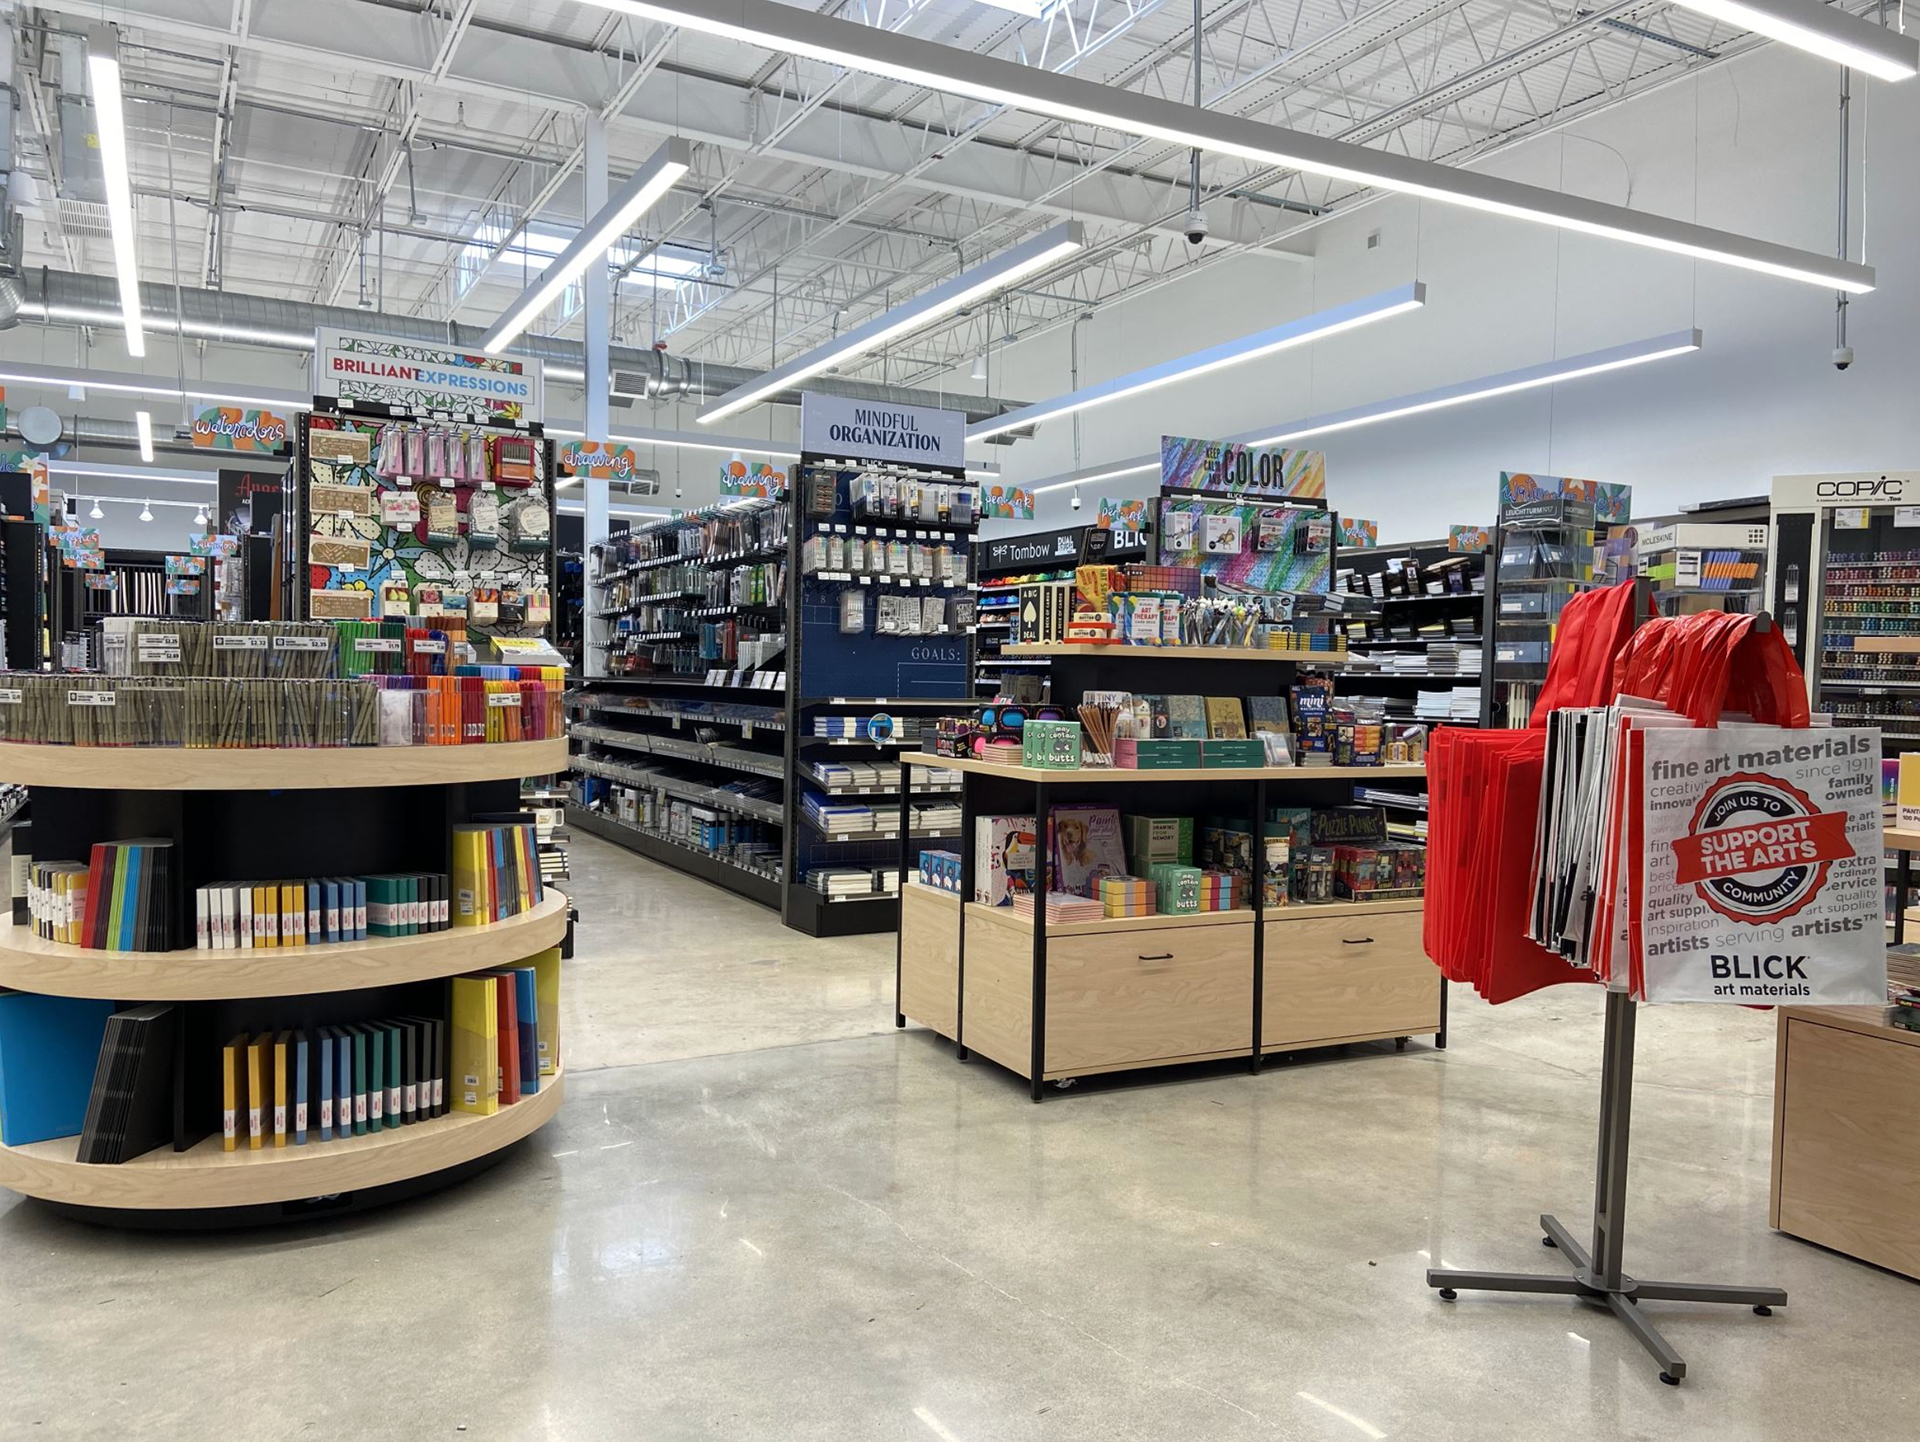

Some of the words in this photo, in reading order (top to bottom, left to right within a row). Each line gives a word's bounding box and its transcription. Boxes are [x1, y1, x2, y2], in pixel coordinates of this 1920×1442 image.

[195, 412, 285, 441] watercolors
[854, 408, 919, 432] MINDFUL
[829, 424, 941, 452] ORGANIZATION
[564, 445, 633, 477] drawing
[861, 458, 884, 467] BLICK
[1223, 449, 1285, 489] COLOR
[722, 461, 786, 496] drawing
[1641, 533, 1673, 547] MOLESKINE
[1010, 542, 1051, 561] Tombow
[1029, 589, 1037, 597] BIG
[1023, 631, 1036, 639] DEAL
[911, 647, 961, 661] GOALS:
[1300, 694, 1324, 708] mini
[1048, 753, 1075, 762] butts
[1652, 760, 1699, 781] fine
[1704, 753, 1731, 775] art
[1738, 734, 1871, 769] materials
[1795, 764, 1841, 780] since
[1846, 757, 1873, 773] 1911
[1650, 779, 1711, 798] creativi
[1828, 773, 1874, 789] family
[1825, 784, 1874, 801] owned
[1714, 800, 1738, 822] JOIN
[1740, 797, 1759, 807] US
[1762, 798, 1781, 812] TO
[1859, 811, 1875, 820] art
[1700, 821, 1811, 855] SUPPORT
[1650, 855, 1671, 868] art
[1700, 850, 1748, 874] THE
[1752, 840, 1818, 867] ARTS
[1838, 856, 1877, 869] extra
[1649, 869, 1676, 882] best
[1833, 868, 1878, 879] ordinary
[1649, 882, 1685, 896] prices
[1722, 871, 1799, 903] COMMUNITY
[1176, 900, 1198, 909] butts
[1648, 894, 1693, 909] quality
[1836, 890, 1878, 903] quality
[1647, 911, 1666, 921] art
[1806, 905, 1823, 916] art
[1827, 900, 1878, 914] supplies
[1648, 918, 1719, 937] inspiration
[1648, 936, 1710, 956] artists
[1716, 928, 1785, 948] serving
[1711, 955, 1809, 980] BLICK
[1714, 984, 1736, 996] art
[1740, 983, 1811, 996] materials
